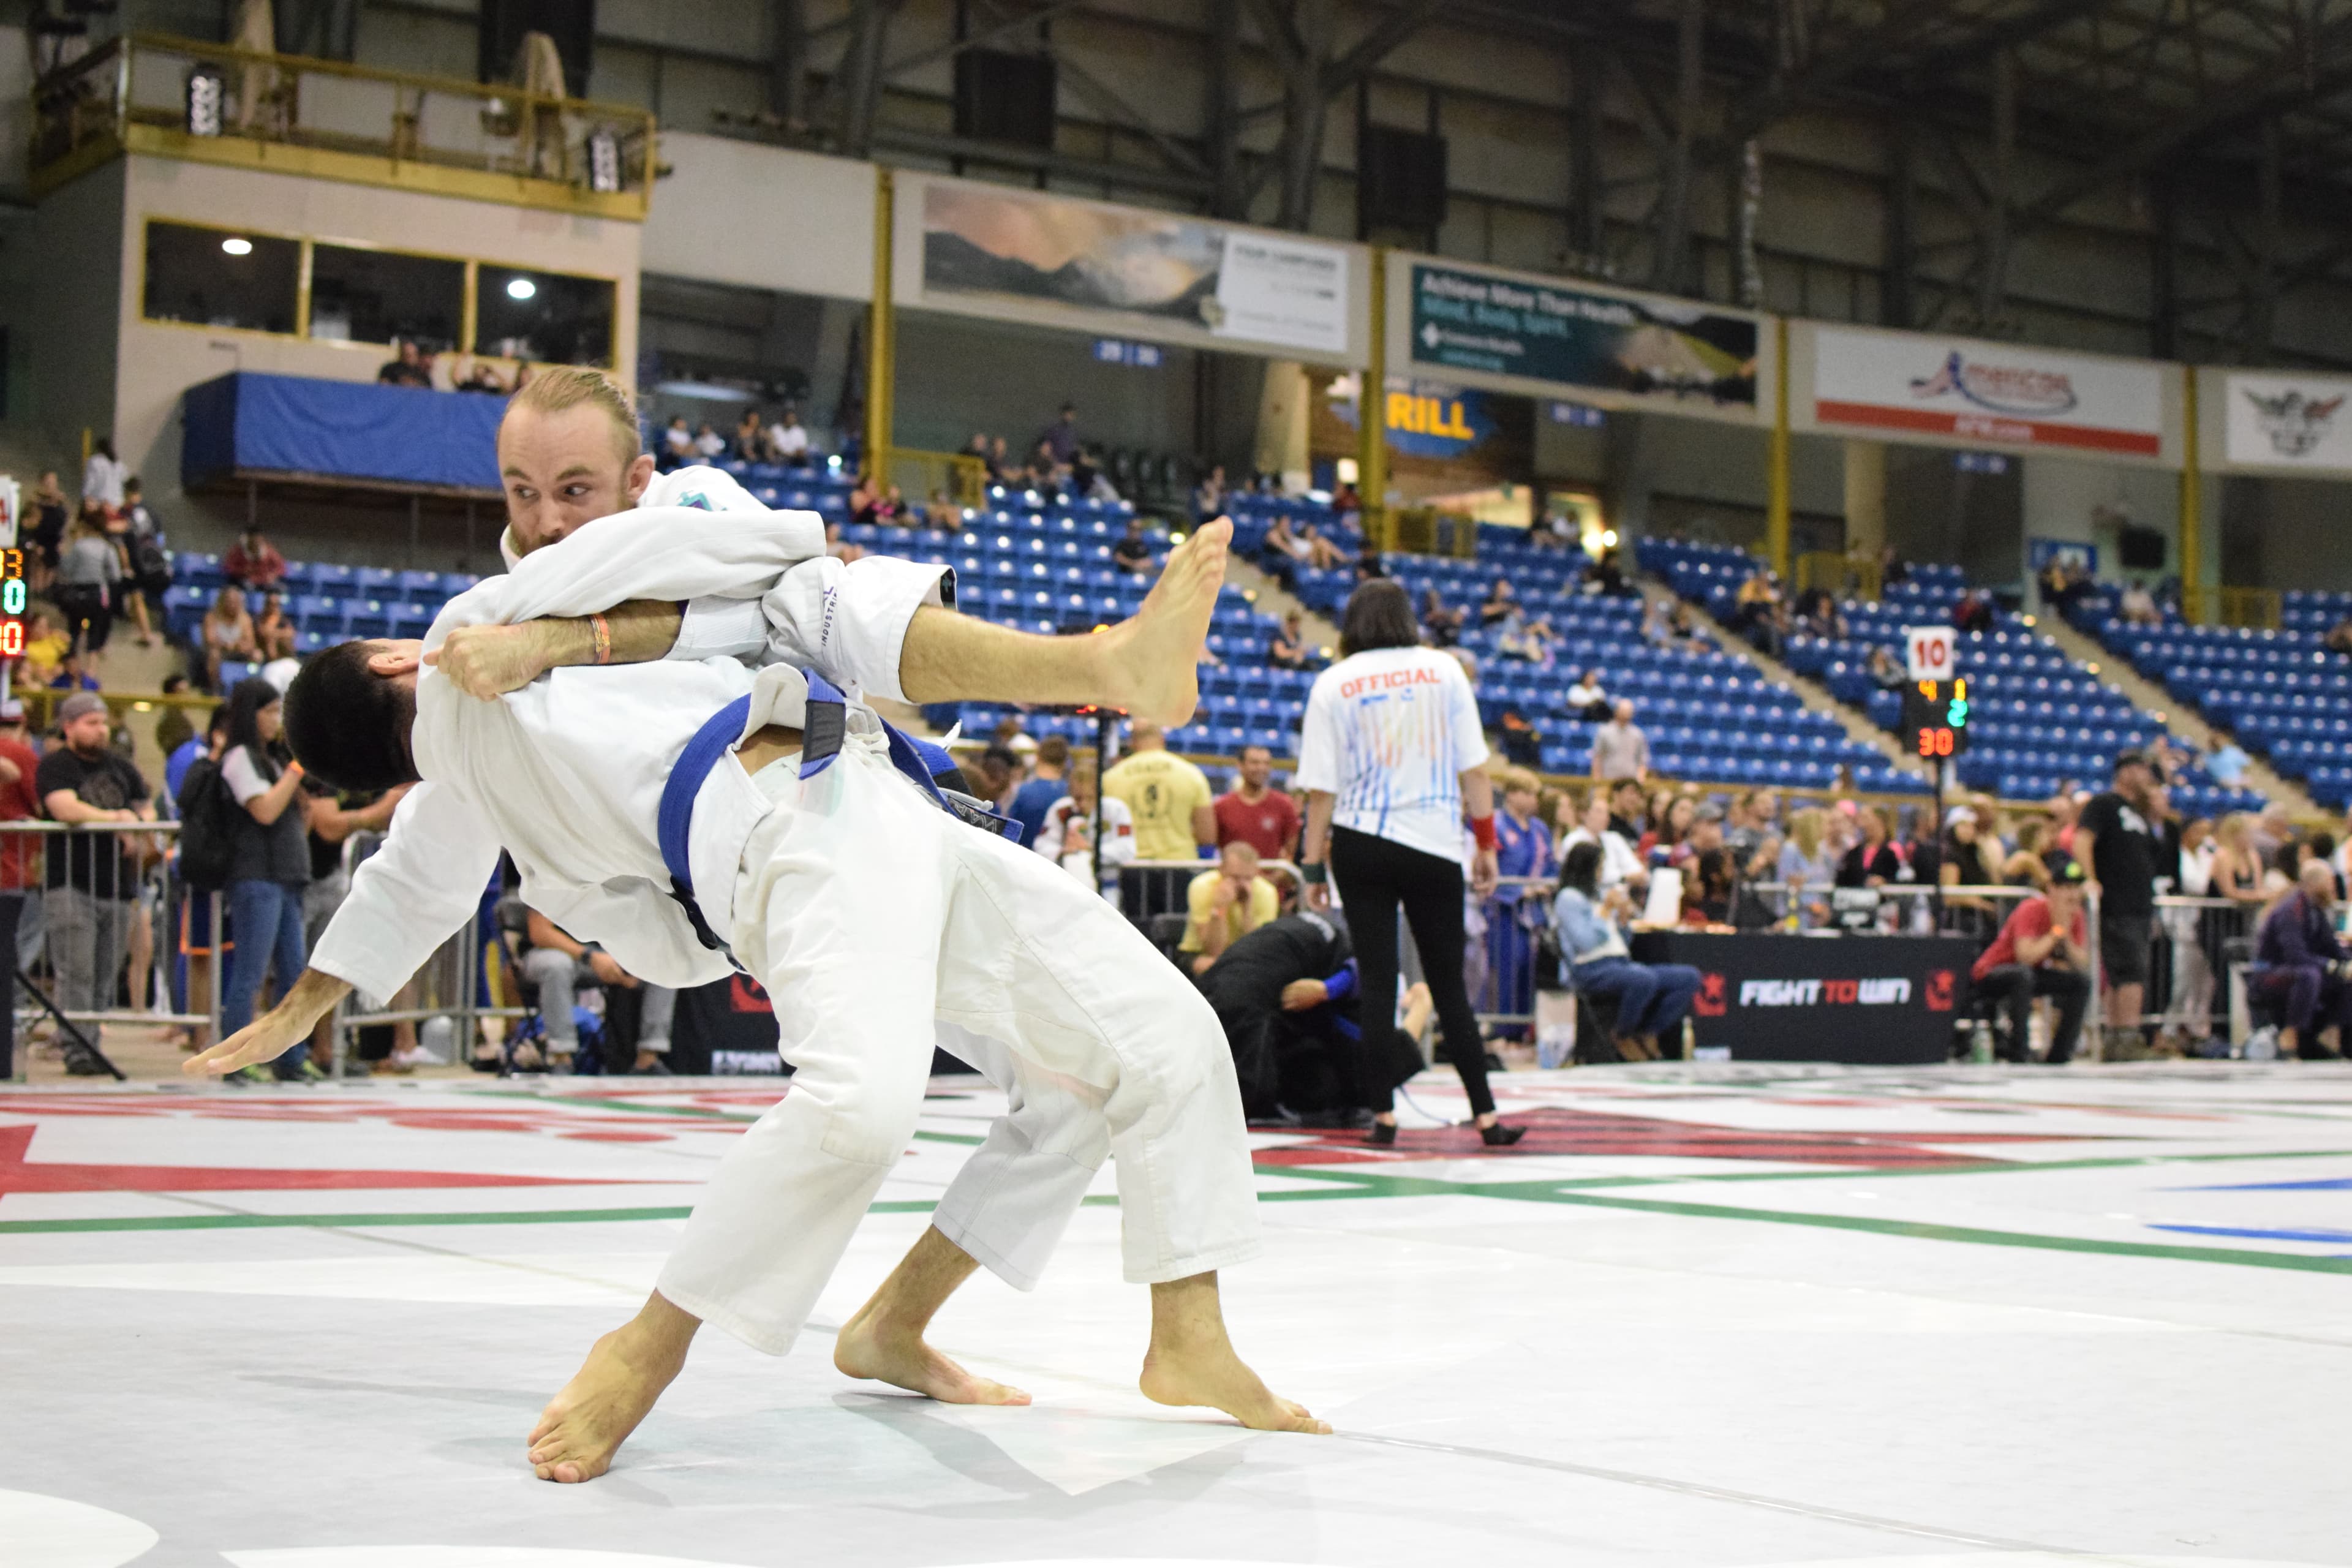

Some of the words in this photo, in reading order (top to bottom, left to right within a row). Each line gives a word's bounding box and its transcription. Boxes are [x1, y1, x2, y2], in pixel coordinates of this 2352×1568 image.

[1386, 392, 1475, 441] RILL
[4, 579, 26, 614] 0
[0, 620, 23, 655] 0
[1917, 638, 1945, 669] 10
[1340, 668, 1441, 698] OFFICIAL
[1918, 727, 1954, 756] 30
